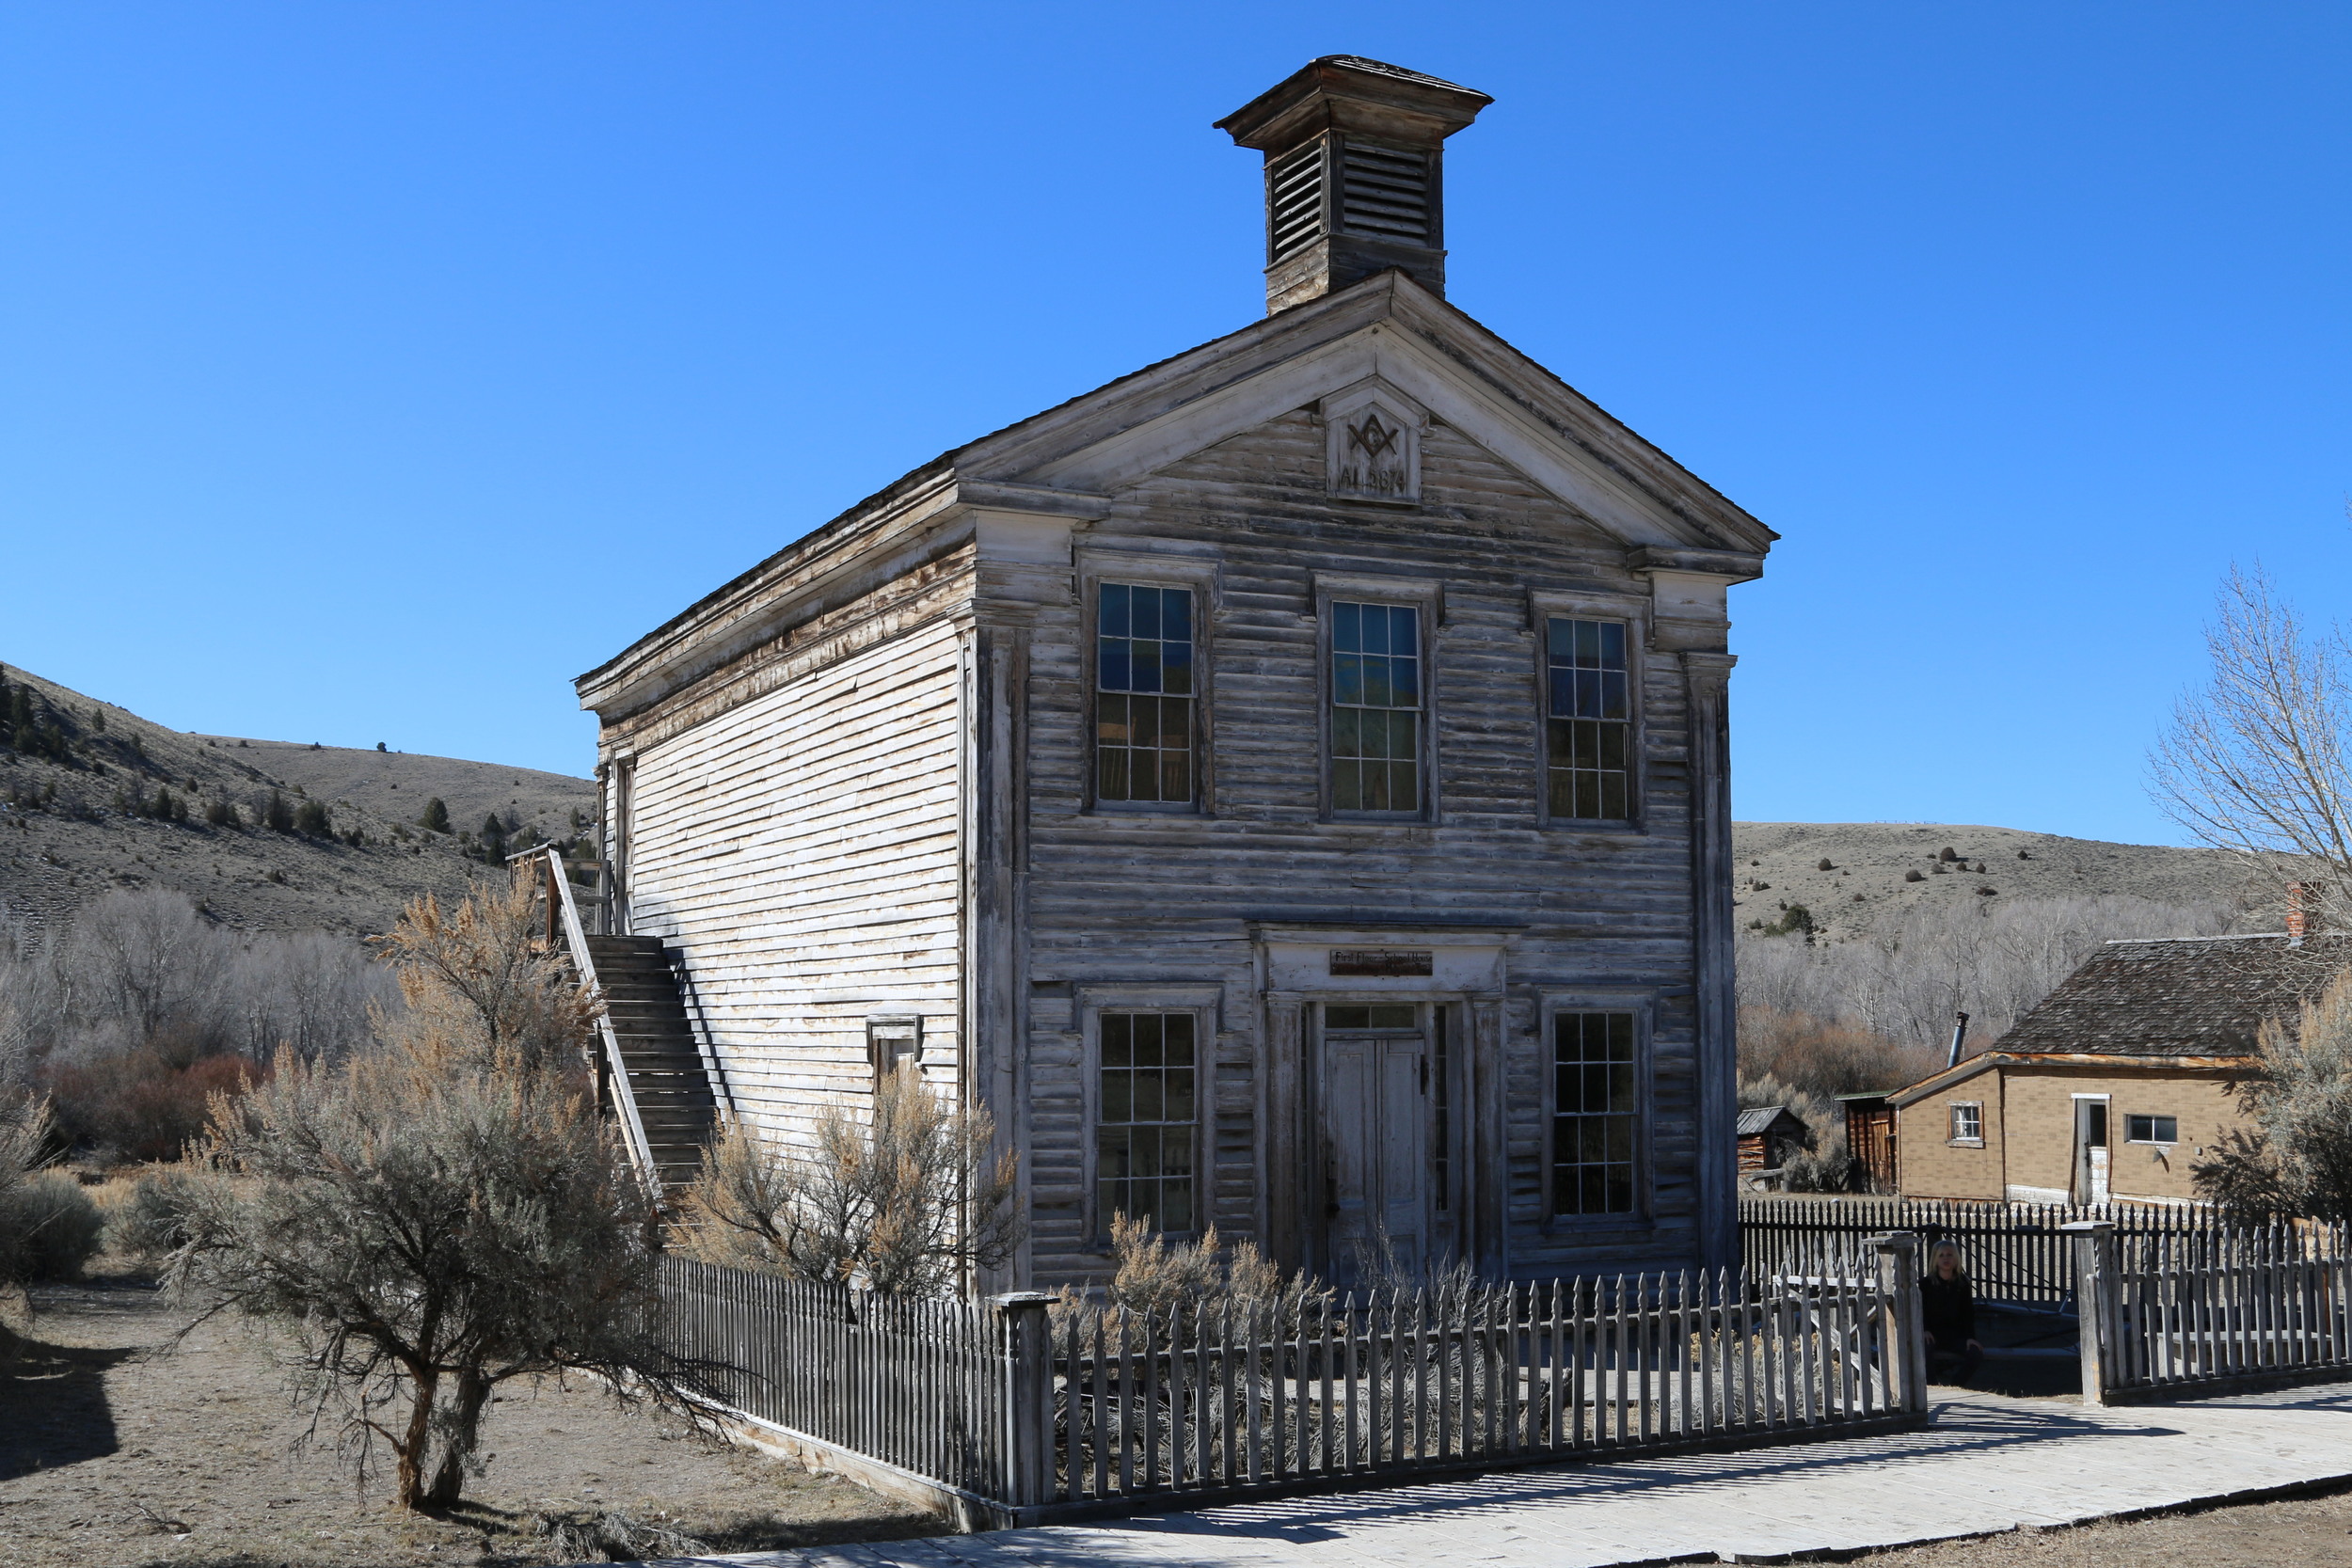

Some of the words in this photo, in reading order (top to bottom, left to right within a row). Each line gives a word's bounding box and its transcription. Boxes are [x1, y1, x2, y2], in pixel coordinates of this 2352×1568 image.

[1335, 952, 1354, 961] First
[1357, 952, 1378, 962] Floor
[1385, 952, 1409, 962] School
